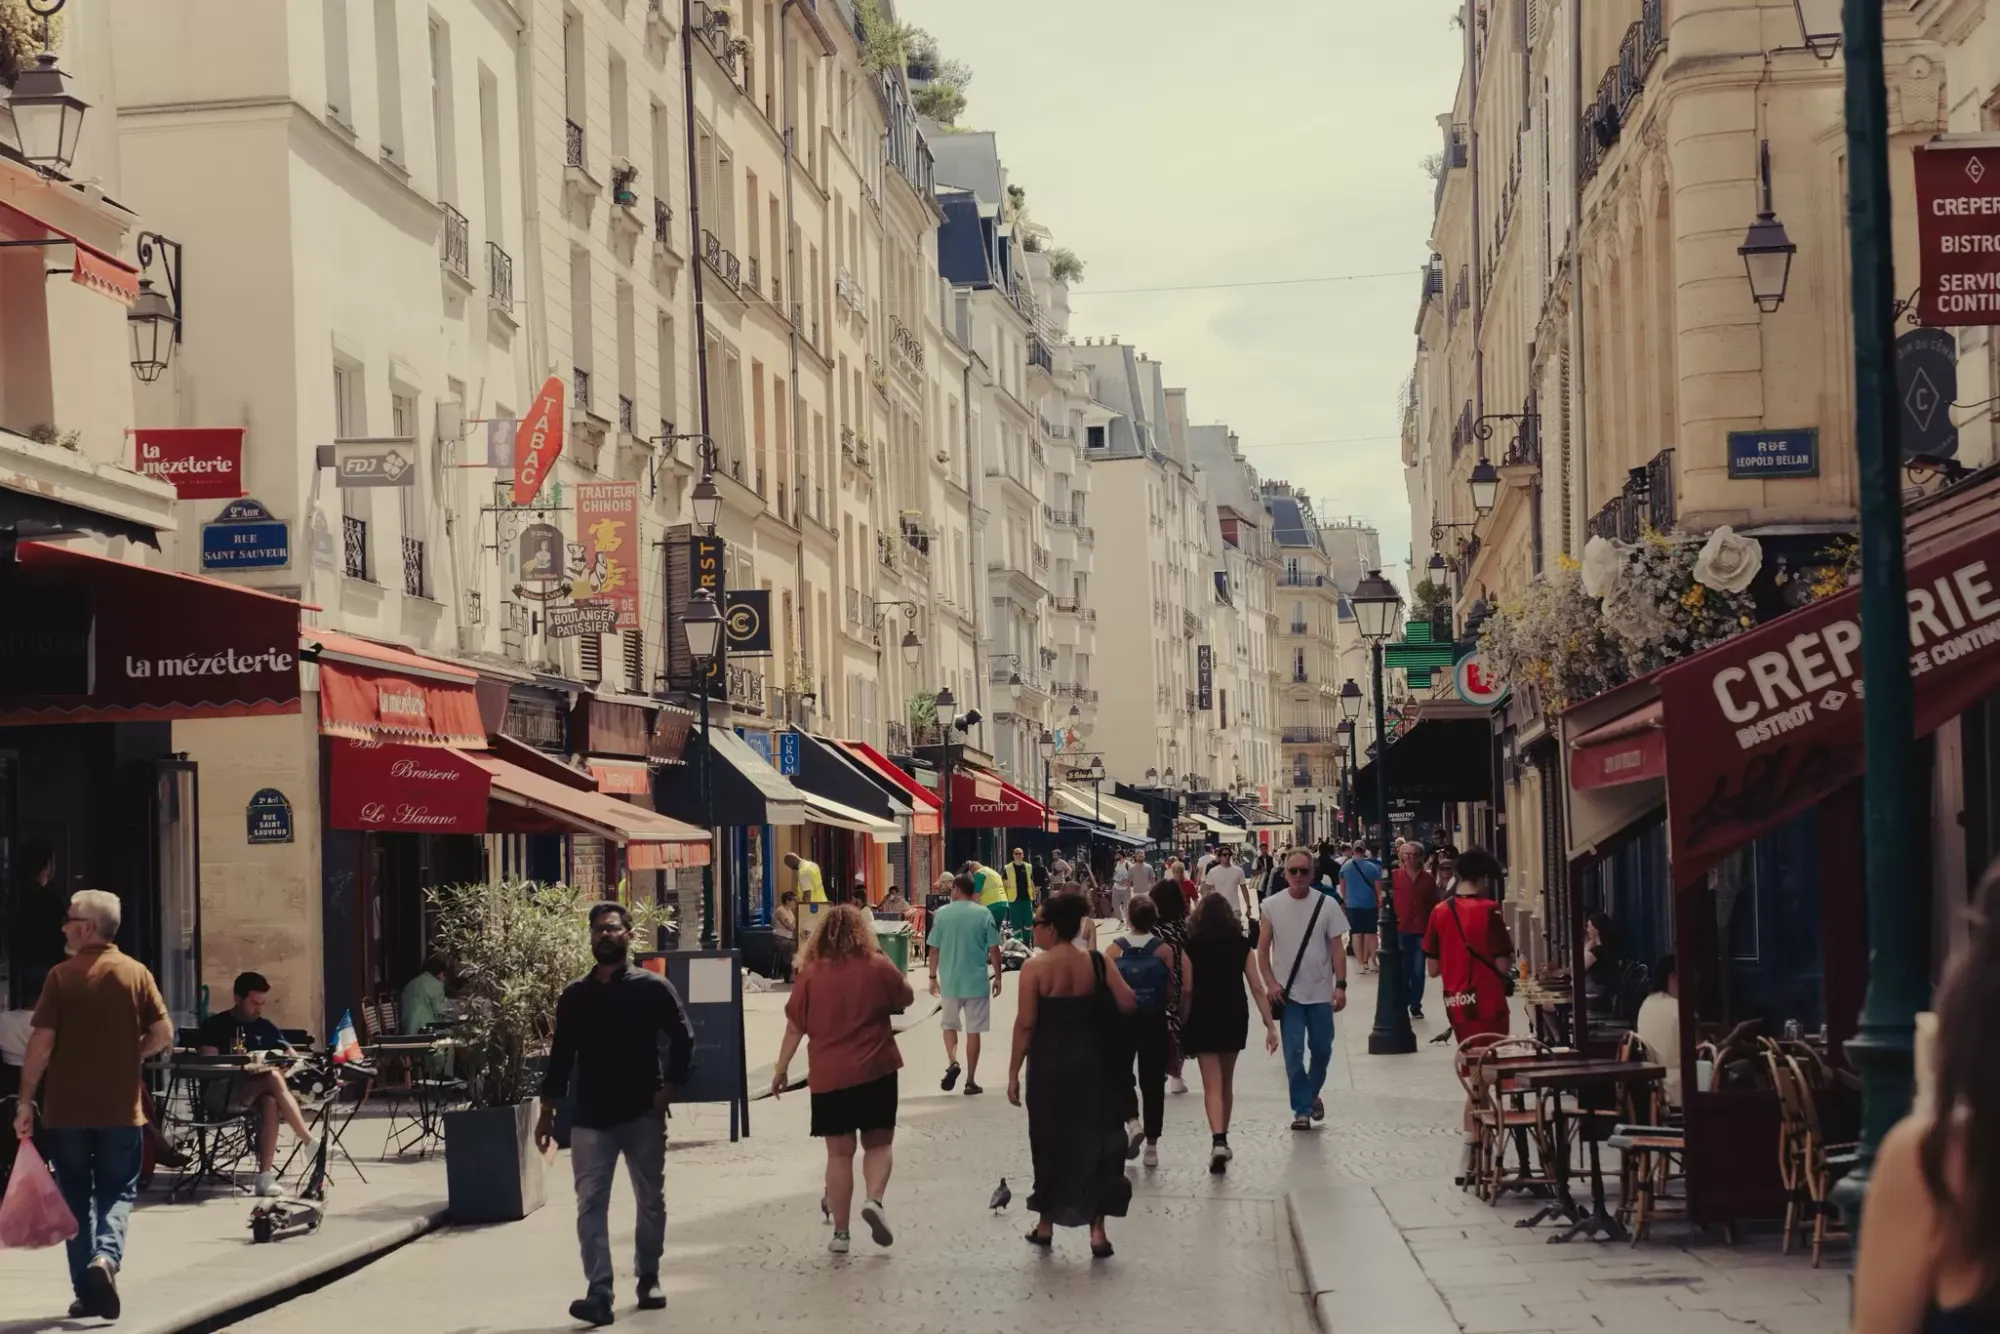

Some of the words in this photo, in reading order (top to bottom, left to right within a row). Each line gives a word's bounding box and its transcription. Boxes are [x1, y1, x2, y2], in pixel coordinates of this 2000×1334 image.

[521, 396, 558, 485] TABAC
[1757, 441, 1788, 452] RUE
[142, 442, 160, 459] la
[345, 458, 376, 473] FDJ
[1776, 454, 1809, 466] BELLAN
[579, 485, 636, 499] TRAITEUR
[582, 499, 632, 513] CHINOIS
[233, 534, 257, 544] RUE
[203, 551, 235, 561] SAINT
[238, 548, 287, 559] SAUVEUR
[621, 599, 634, 611] DE
[554, 610, 615, 625] BOULANGER
[557, 622, 609, 636] PATISSIER
[126, 655, 151, 678] la
[158, 647, 292, 676] mézéterie
[1200, 648, 1209, 707] HÔTEL
[1736, 701, 1814, 750] BISTROT
[784, 735, 795, 774] GROM
[391, 759, 460, 781] Brasserie
[359, 802, 386, 824] Le
[393, 803, 458, 825] Havane
